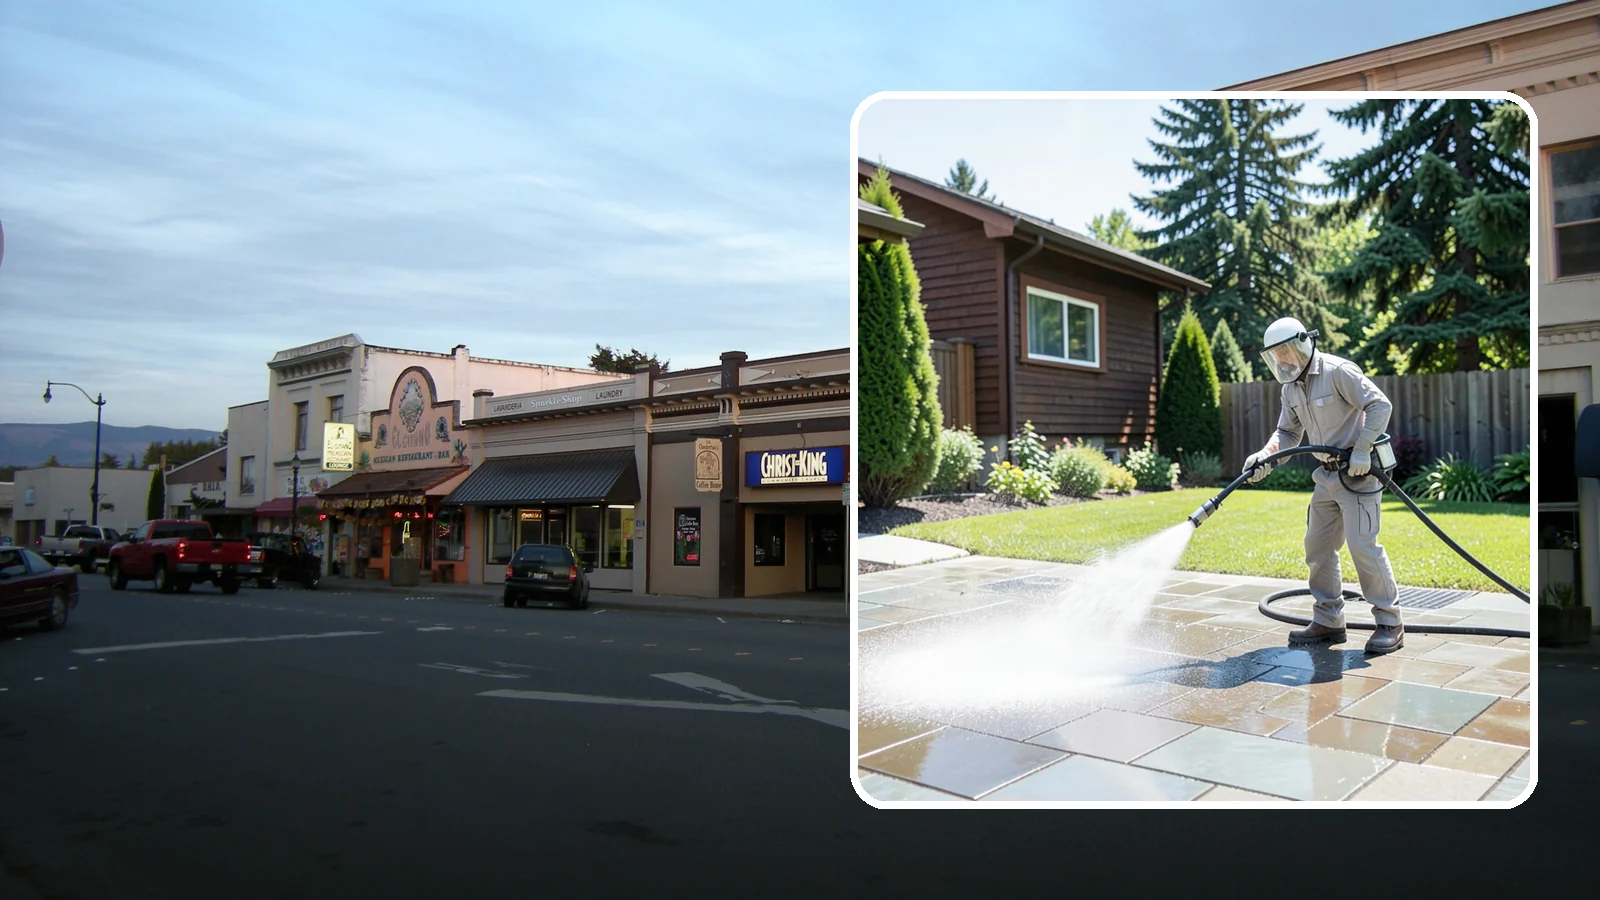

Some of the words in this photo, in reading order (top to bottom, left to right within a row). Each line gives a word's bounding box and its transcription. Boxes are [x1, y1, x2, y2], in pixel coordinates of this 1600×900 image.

[493, 402, 522, 413] LAVANDERIA
[531, 399, 560, 410] Sparkle
[562, 395, 583, 406] Shop
[596, 389, 624, 400] LAUNDRY
[373, 455, 396, 464] MEXICAN
[398, 452, 433, 462] RESTAURANT
[438, 450, 450, 459] BAR
[799, 450, 827, 477] KING
[696, 480, 709, 489] Coffee
[710, 480, 722, 489] House
